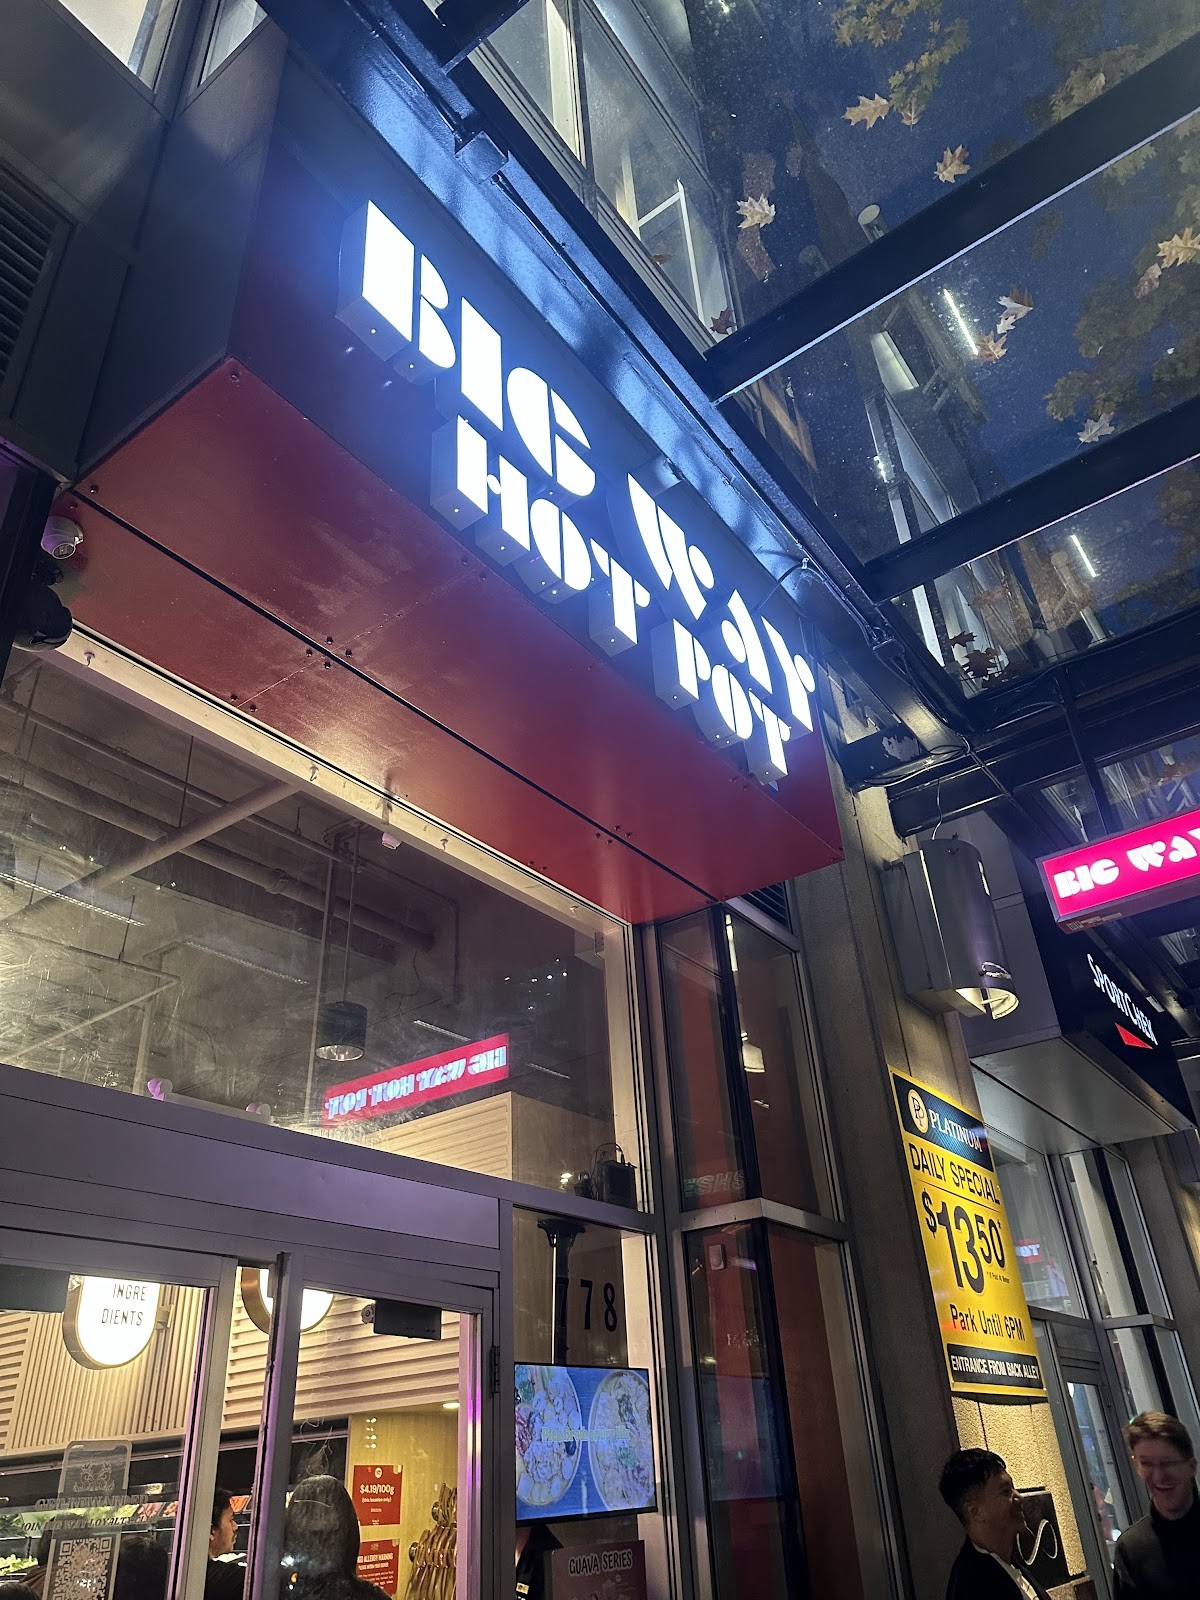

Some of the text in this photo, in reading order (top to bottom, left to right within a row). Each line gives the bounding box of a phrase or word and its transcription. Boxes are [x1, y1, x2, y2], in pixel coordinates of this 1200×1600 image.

[362, 200, 816, 732] BIG WAY
[457, 414, 792, 778] HOT POT
[1053, 858, 1120, 899] BIG
[928, 1108, 983, 1152] PLATINUM
[908, 1142, 1000, 1205] DAILY SPECIAL
[112, 1283, 147, 1301] INGRE
[101, 1308, 144, 1326] DIENTS
[950, 1303, 1026, 1341] Park Until 6PM
[950, 1355, 1040, 1379] ENTRANCE FROM BACK ALLEY
[360, 1484, 395, 1496] $4.19/100g
[569, 1551, 632, 1575] GUAVA SERIES
